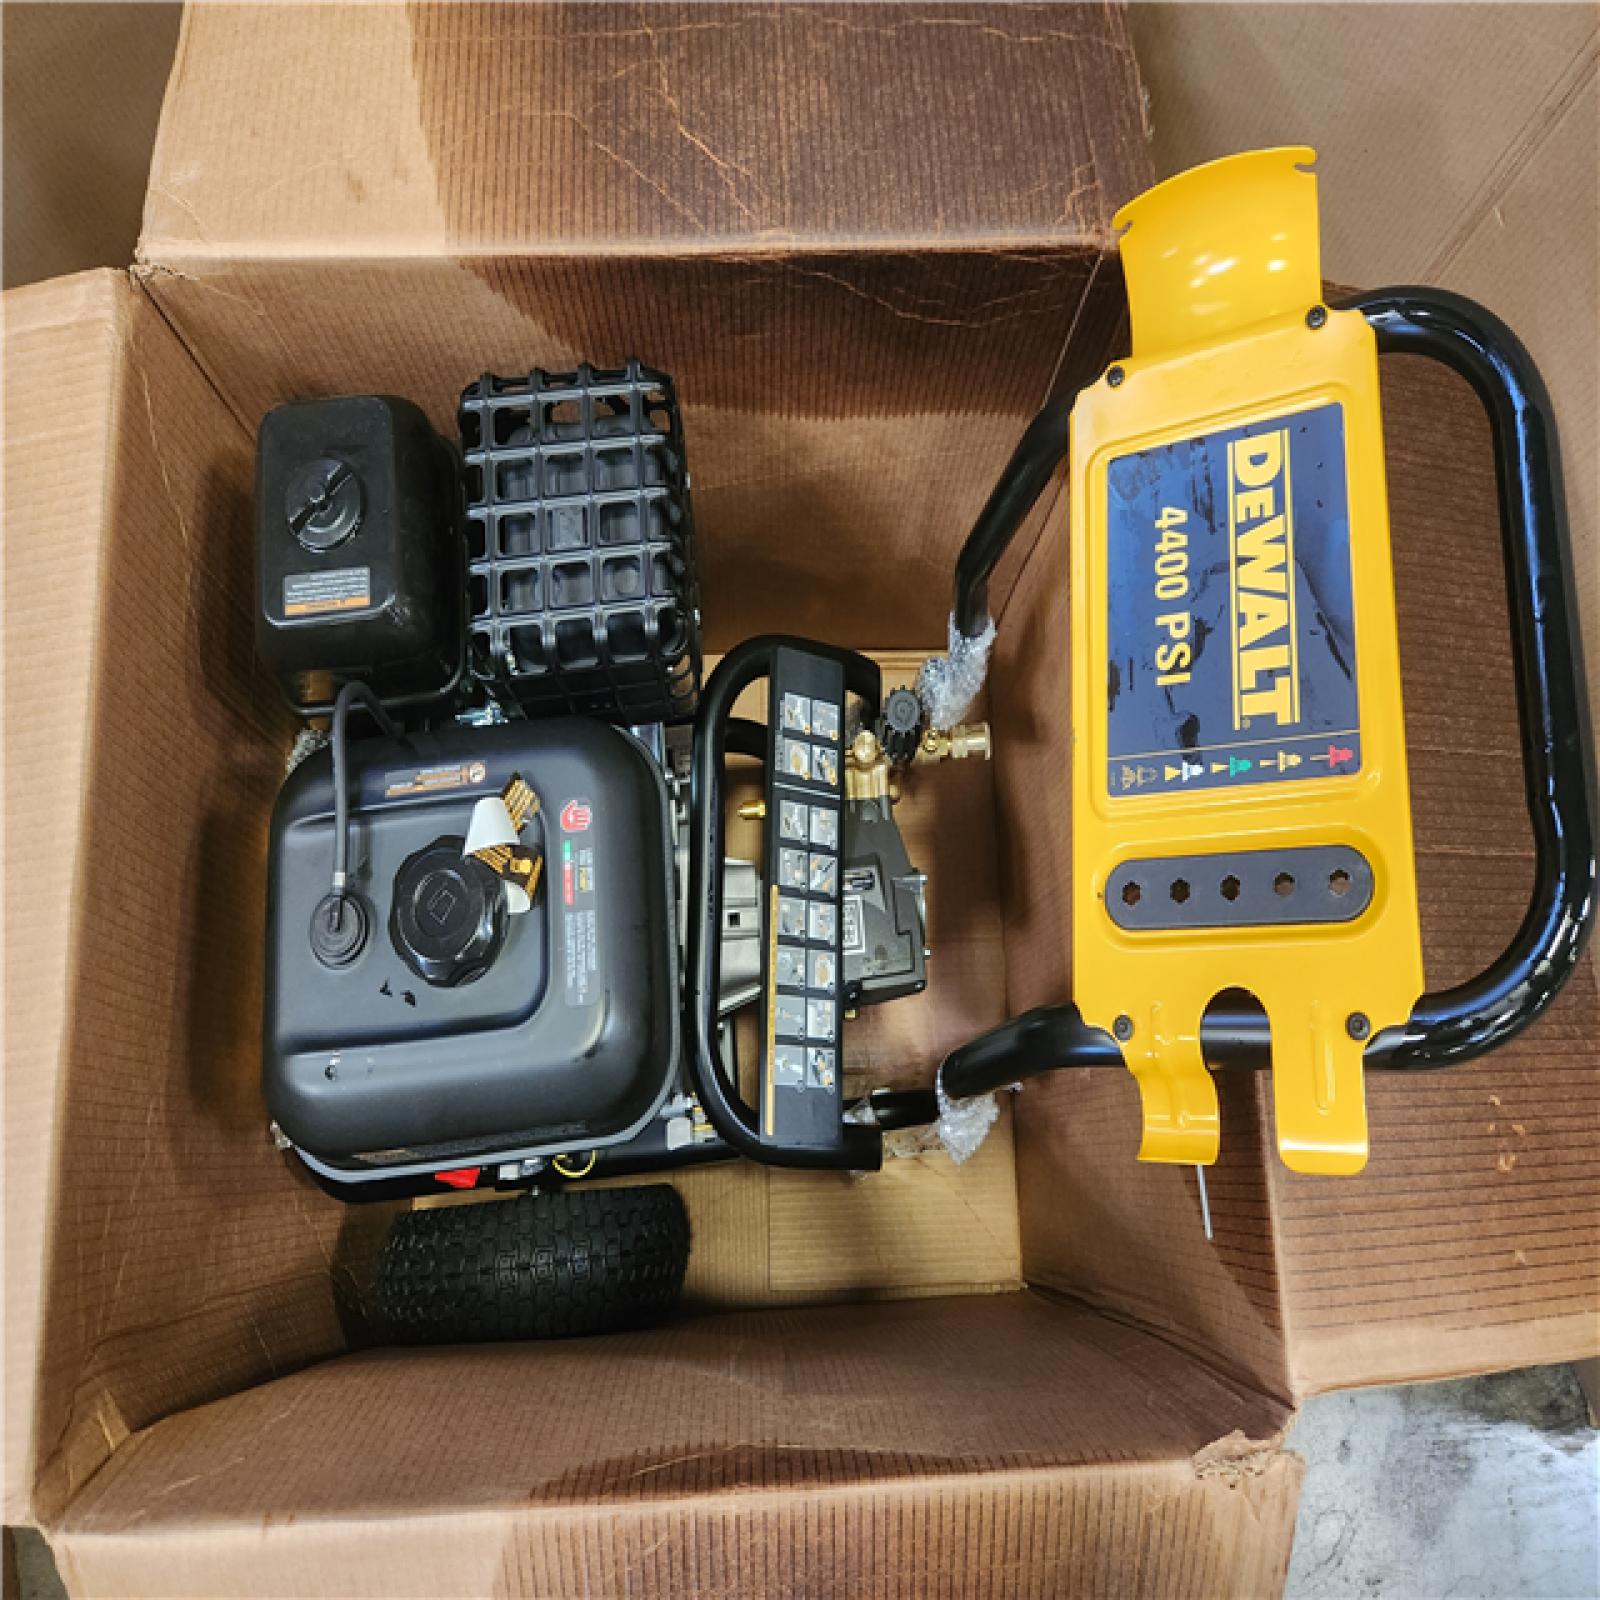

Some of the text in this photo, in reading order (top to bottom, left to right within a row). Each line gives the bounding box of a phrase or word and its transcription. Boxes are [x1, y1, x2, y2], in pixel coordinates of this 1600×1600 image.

[1154, 506, 1192, 687] 4400 PSI
[1234, 429, 1292, 726] DEWALT
